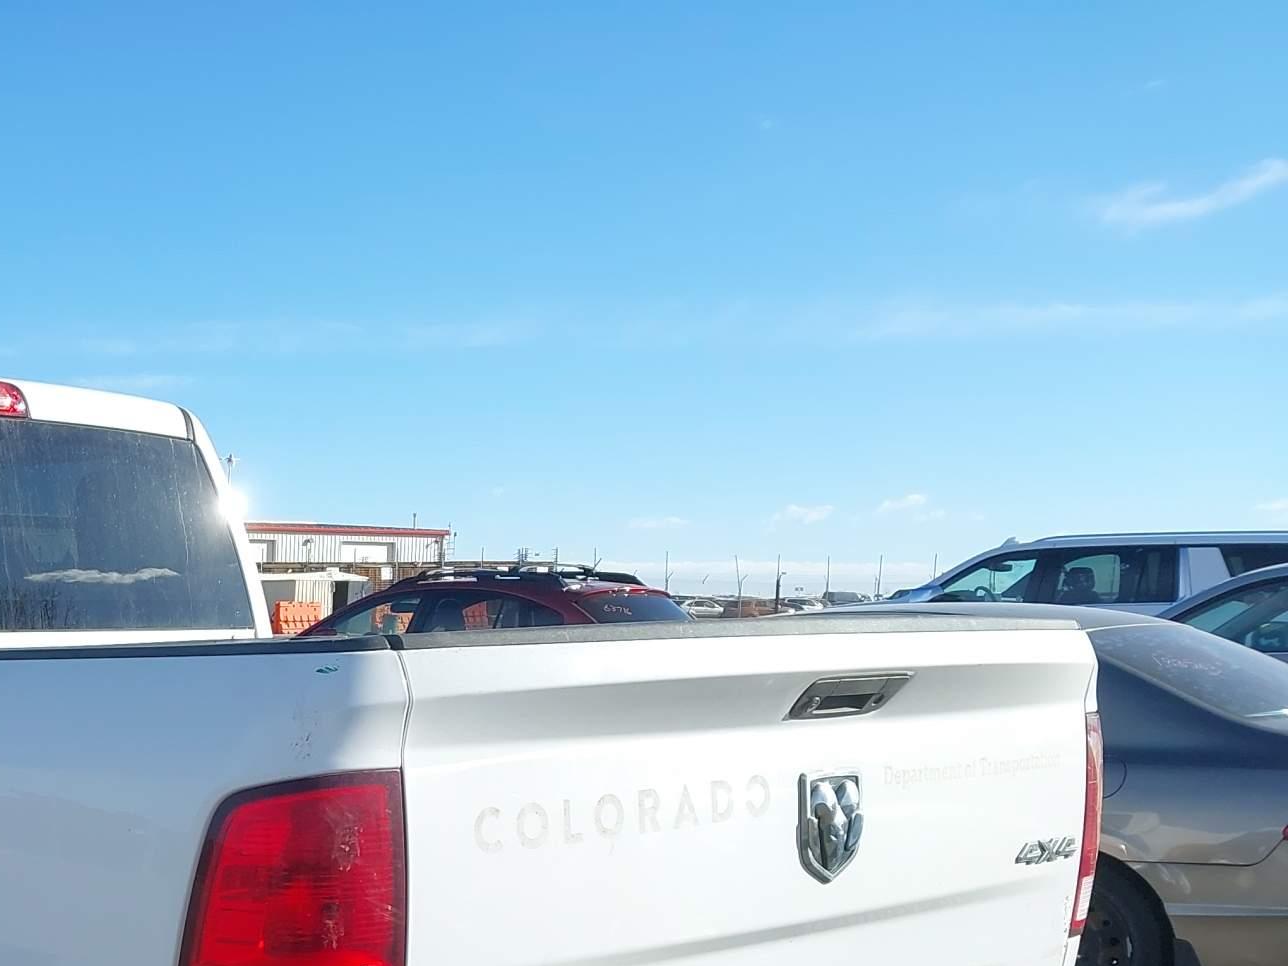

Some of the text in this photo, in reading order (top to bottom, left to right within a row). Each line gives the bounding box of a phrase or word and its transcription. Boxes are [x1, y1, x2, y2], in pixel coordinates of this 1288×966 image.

[882, 754, 1061, 790] Department of Transportation
[473, 774, 771, 854] COLORADO
